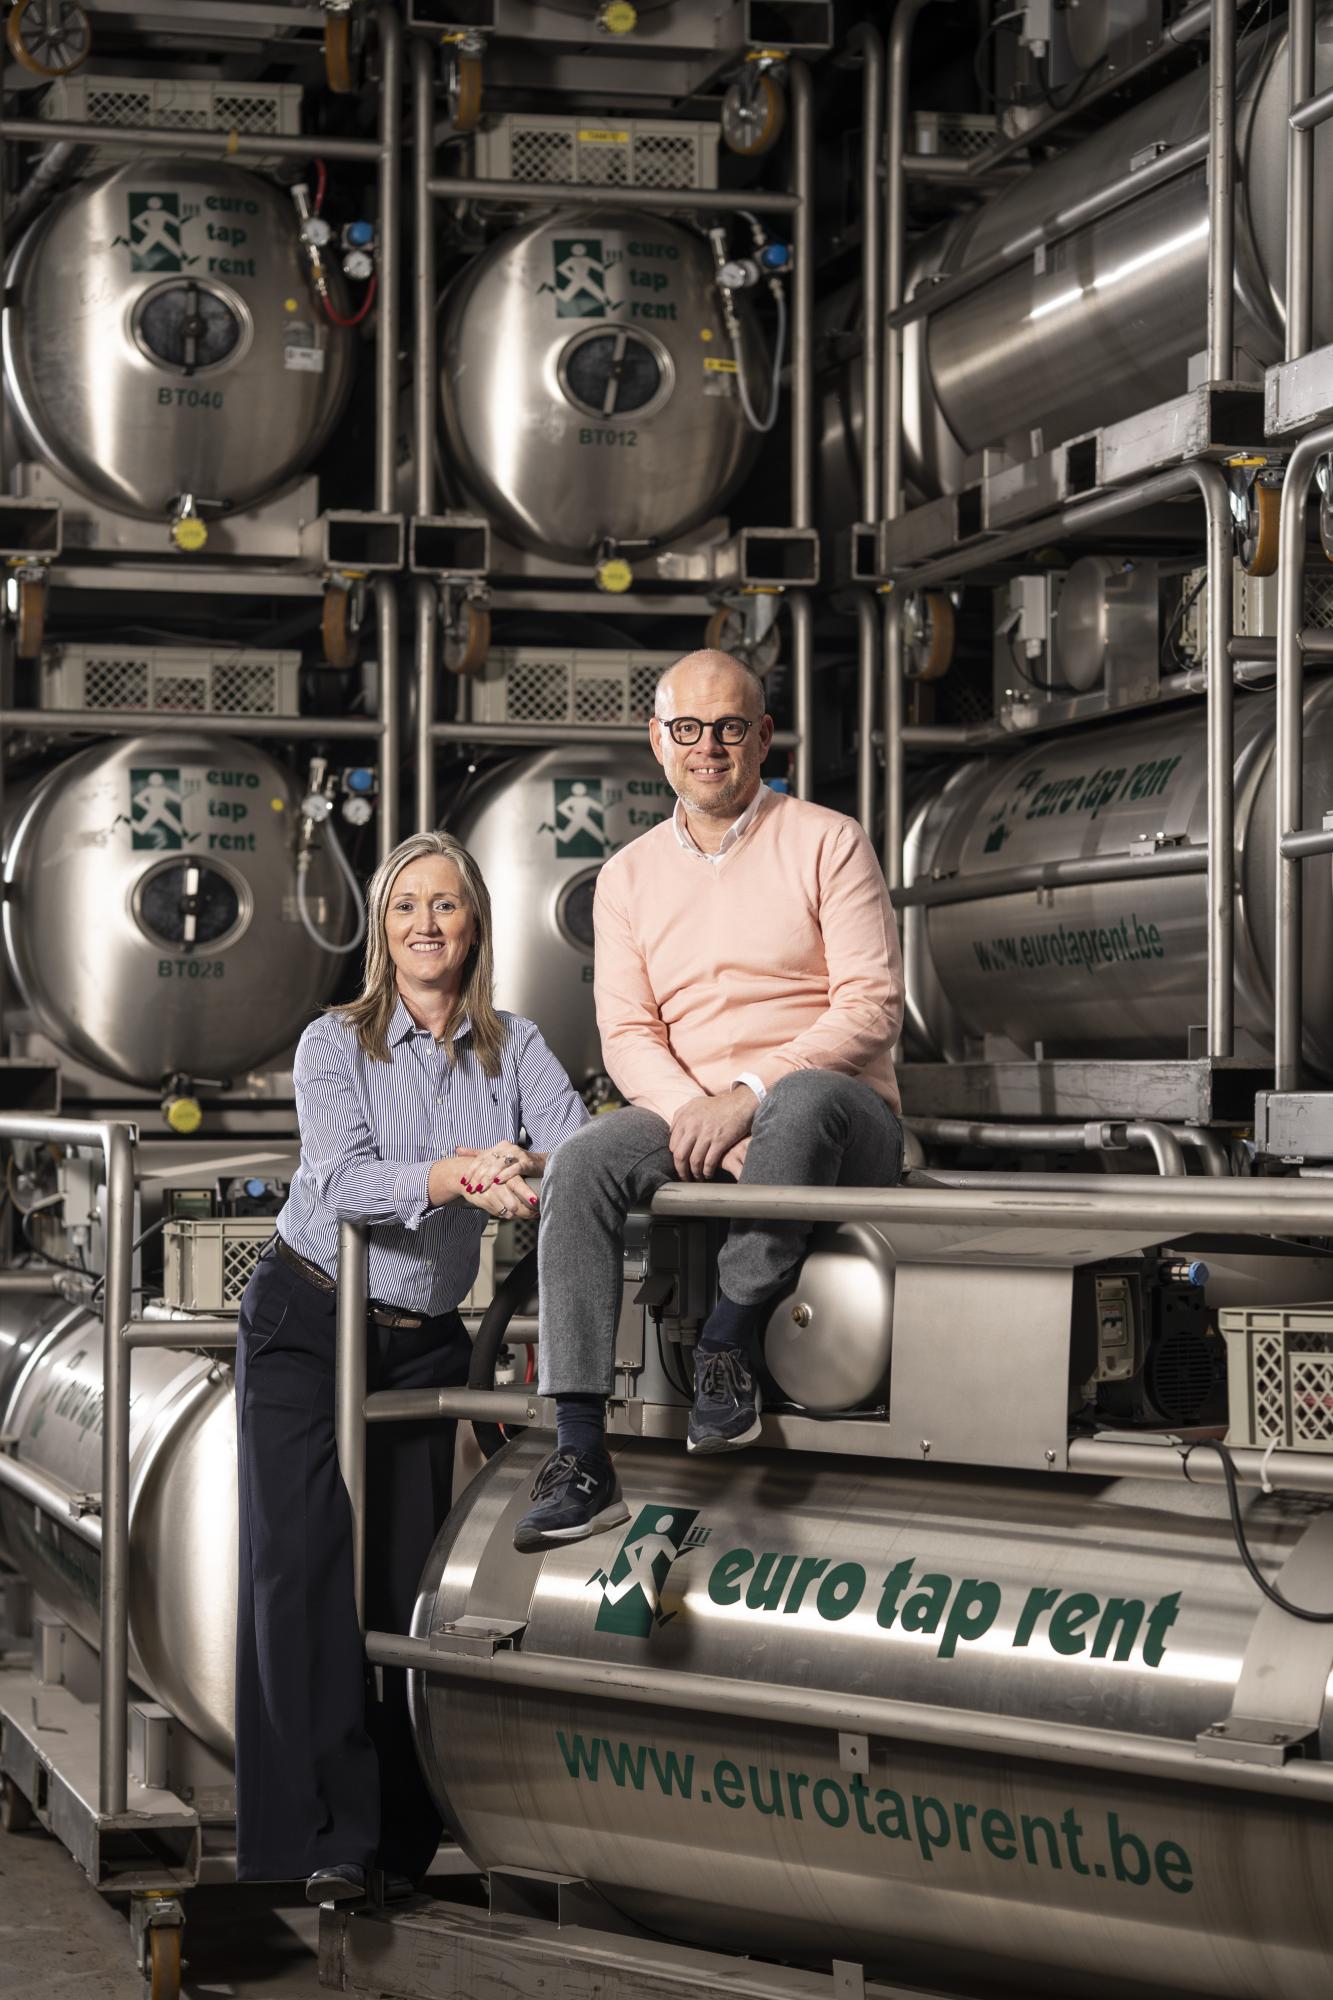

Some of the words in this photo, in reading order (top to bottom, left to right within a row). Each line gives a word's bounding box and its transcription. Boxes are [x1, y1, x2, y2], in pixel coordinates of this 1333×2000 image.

[205, 195, 259, 215] euro
[206, 222, 248, 248] tap
[627, 241, 679, 260] euro
[208, 256, 257, 277] rent
[628, 269, 669, 293] tap
[630, 301, 678, 321] rent
[158, 387, 225, 410] BT040
[579, 428, 639, 448] BT012
[206, 770, 260, 789] euro
[1025, 776, 1086, 821] euro
[1076, 766, 1128, 821] tap
[1118, 754, 1183, 802] rent
[207, 799, 248, 823] tap
[207, 832, 257, 852] rent
[158, 960, 225, 979] BT028
[708, 1548, 865, 1621] euro
[876, 1557, 1002, 1659] tap
[1012, 1587, 1182, 1668] rent
[555, 1730, 1195, 1895] www.eurotaprent.be
